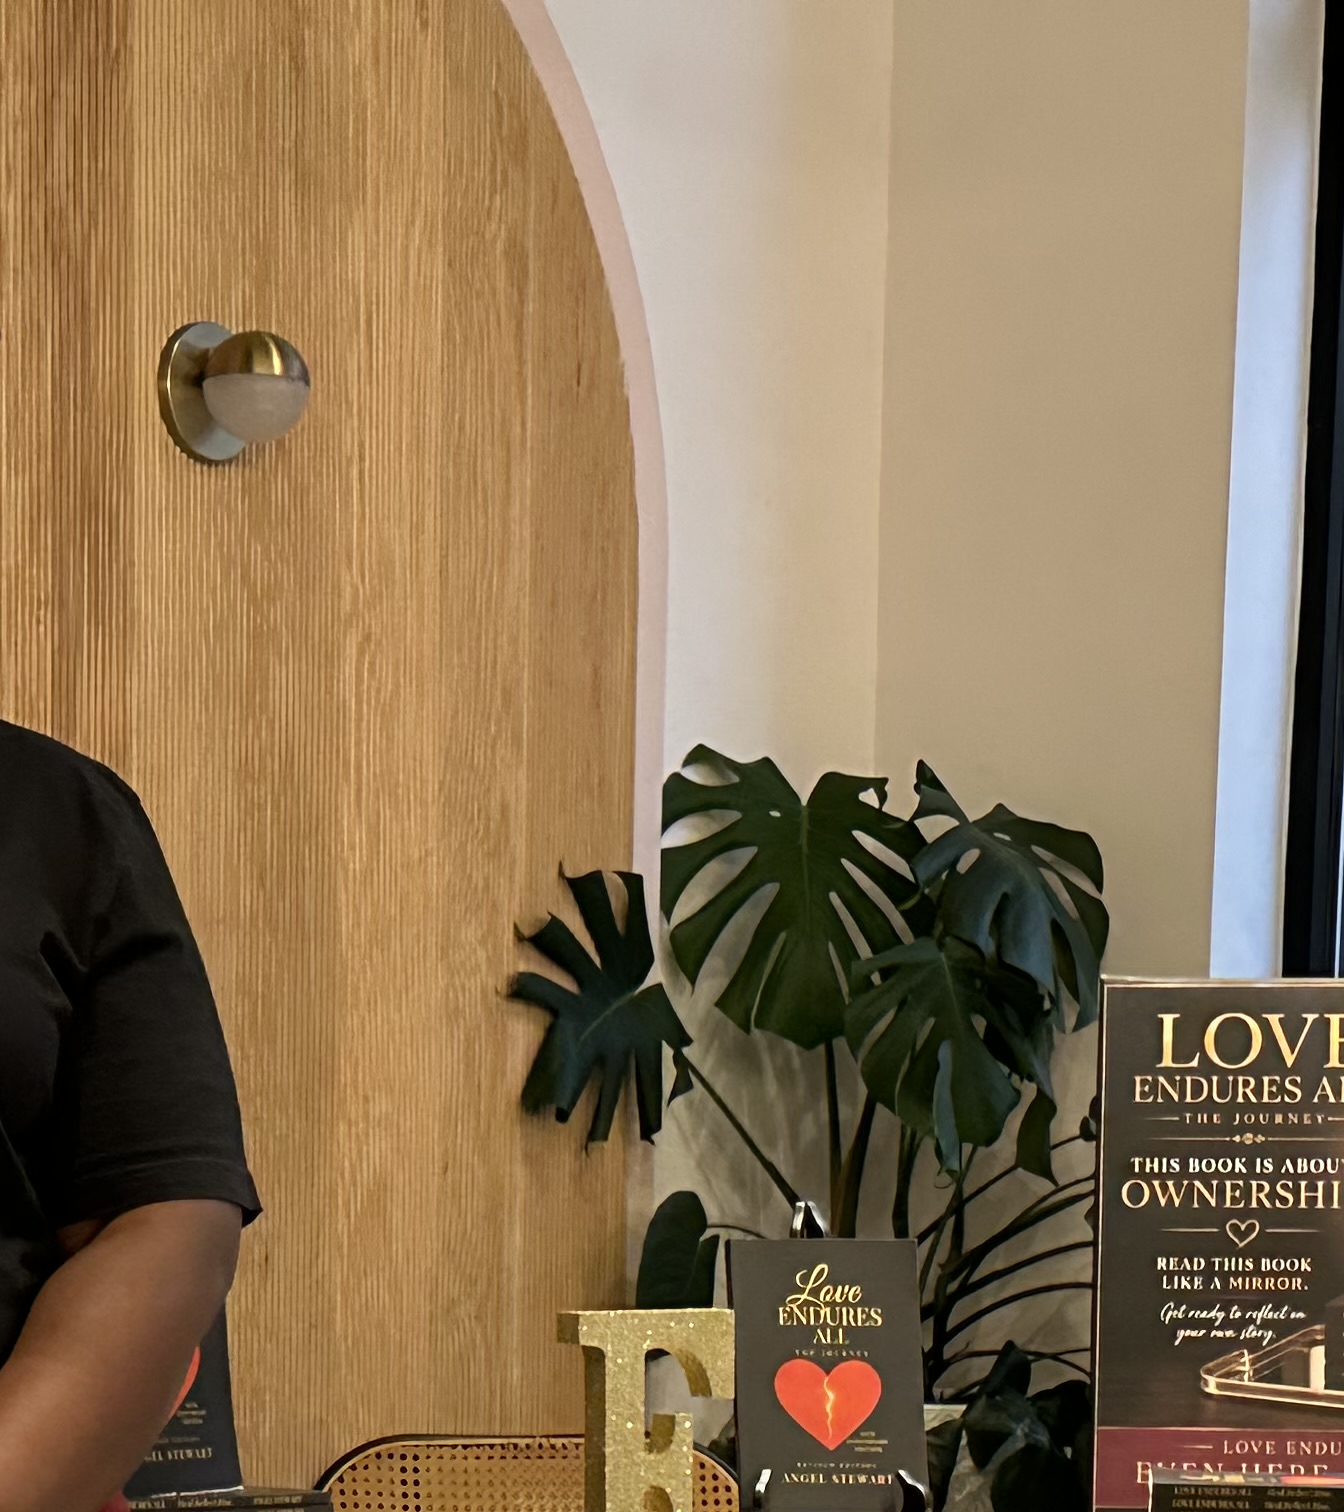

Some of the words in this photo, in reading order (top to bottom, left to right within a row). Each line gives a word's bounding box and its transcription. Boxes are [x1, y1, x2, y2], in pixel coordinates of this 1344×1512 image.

[1133, 1075, 1302, 1104] ENDURES
[1182, 1112, 1221, 1125] THE
[1232, 1112, 1326, 1125] JOURNEY
[1130, 1156, 1180, 1175] THIS
[1188, 1156, 1249, 1175] BOOK
[1255, 1157, 1274, 1175] IS
[1156, 1256, 1206, 1272] READ
[1210, 1256, 1254, 1272] THIS
[1260, 1256, 1313, 1272] BOOK
[785, 1263, 863, 1309] Love
[1161, 1275, 1203, 1291] LIKE
[1209, 1276, 1222, 1291] A
[1228, 1275, 1309, 1292] MIRROR.
[778, 1306, 883, 1327] ENDURES
[1160, 1301, 1187, 1325] Get
[1187, 1303, 1226, 1327] ready
[1228, 1305, 1242, 1320] to
[1245, 1303, 1288, 1326] reflect
[1289, 1311, 1307, 1320] on
[813, 1327, 851, 1345] ALL
[1173, 1328, 1206, 1347] your
[1239, 1323, 1277, 1347] story.
[1222, 1439, 1276, 1455] LOVE
[781, 1472, 827, 1484] ANGEL
[831, 1473, 895, 1485] STEWART
